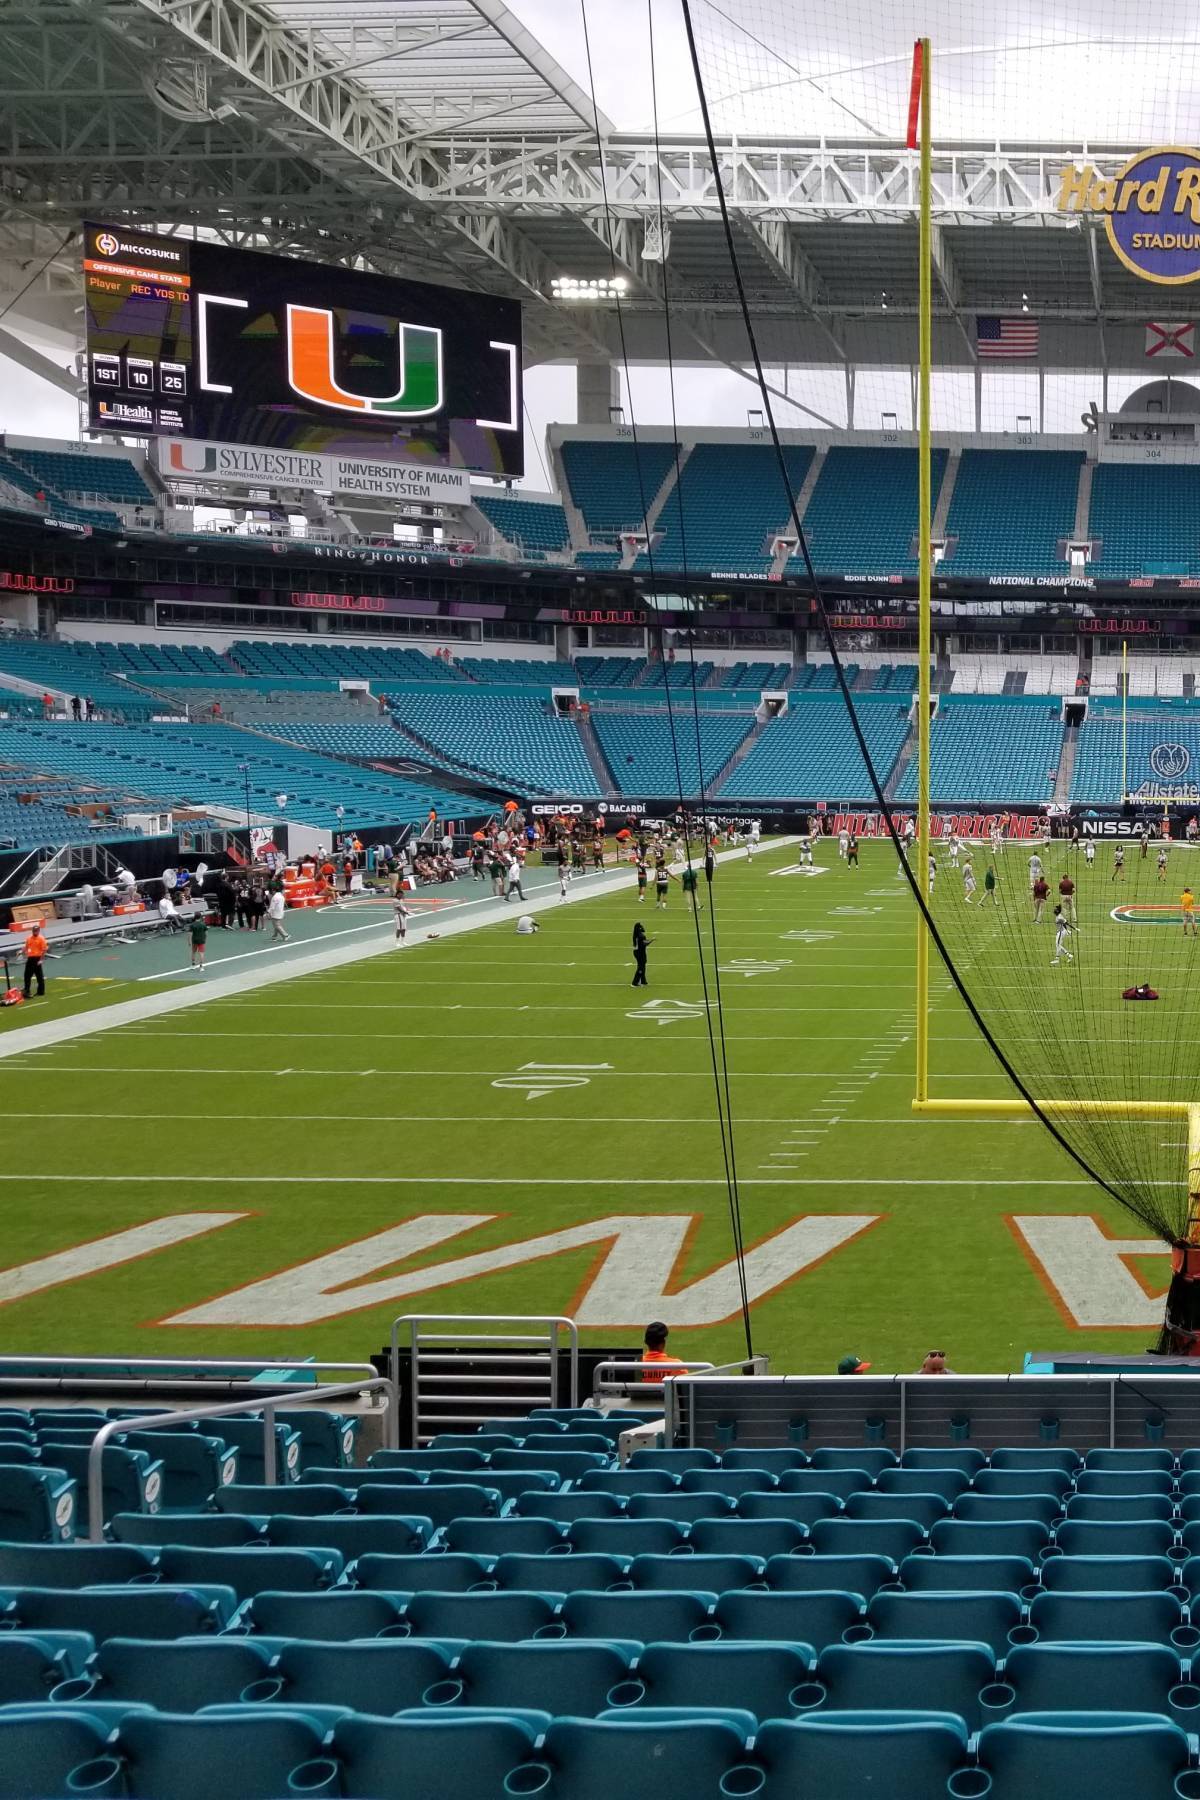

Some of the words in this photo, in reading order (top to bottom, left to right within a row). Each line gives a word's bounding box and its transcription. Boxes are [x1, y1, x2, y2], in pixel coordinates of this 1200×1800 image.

[1057, 164, 1170, 213] Hard
[120, 244, 180, 261] MICCOSUKEE
[137, 270, 159, 280] GAME
[159, 274, 183, 283] STATS
[90, 277, 121, 291] Player
[131, 284, 151, 295] REC
[154, 288, 175, 299] YDS
[176, 291, 189, 301] TD
[96, 368, 118, 380] 1ST
[133, 372, 148, 385] 10
[165, 376, 182, 389] 25
[882, 433, 898, 443] 302
[66, 441, 89, 453] 352
[1145, 449, 1162, 459] 304
[220, 448, 323, 478] SYLVESTER
[220, 470, 274, 481] COMPREHENSIVE
[300, 478, 324, 486] CENTER
[338, 462, 406, 480] UNIVERSITY
[408, 469, 424, 482] OF
[425, 472, 463, 487] MIAMI
[338, 477, 383, 492] HEALTH
[385, 481, 431, 497] SYSTEM
[314, 546, 355, 560] RING
[372, 552, 429, 565] HONOR
[988, 576, 1035, 586] NATIONAL
[1036, 576, 1094, 587] CHAMPIONS
[1135, 780, 1198, 798] Allstate
[531, 804, 584, 815] GEICO
[609, 802, 647, 813] BACARDÍ
[676, 815, 717, 824] RCKET
[490, 1060, 615, 1090] 10
